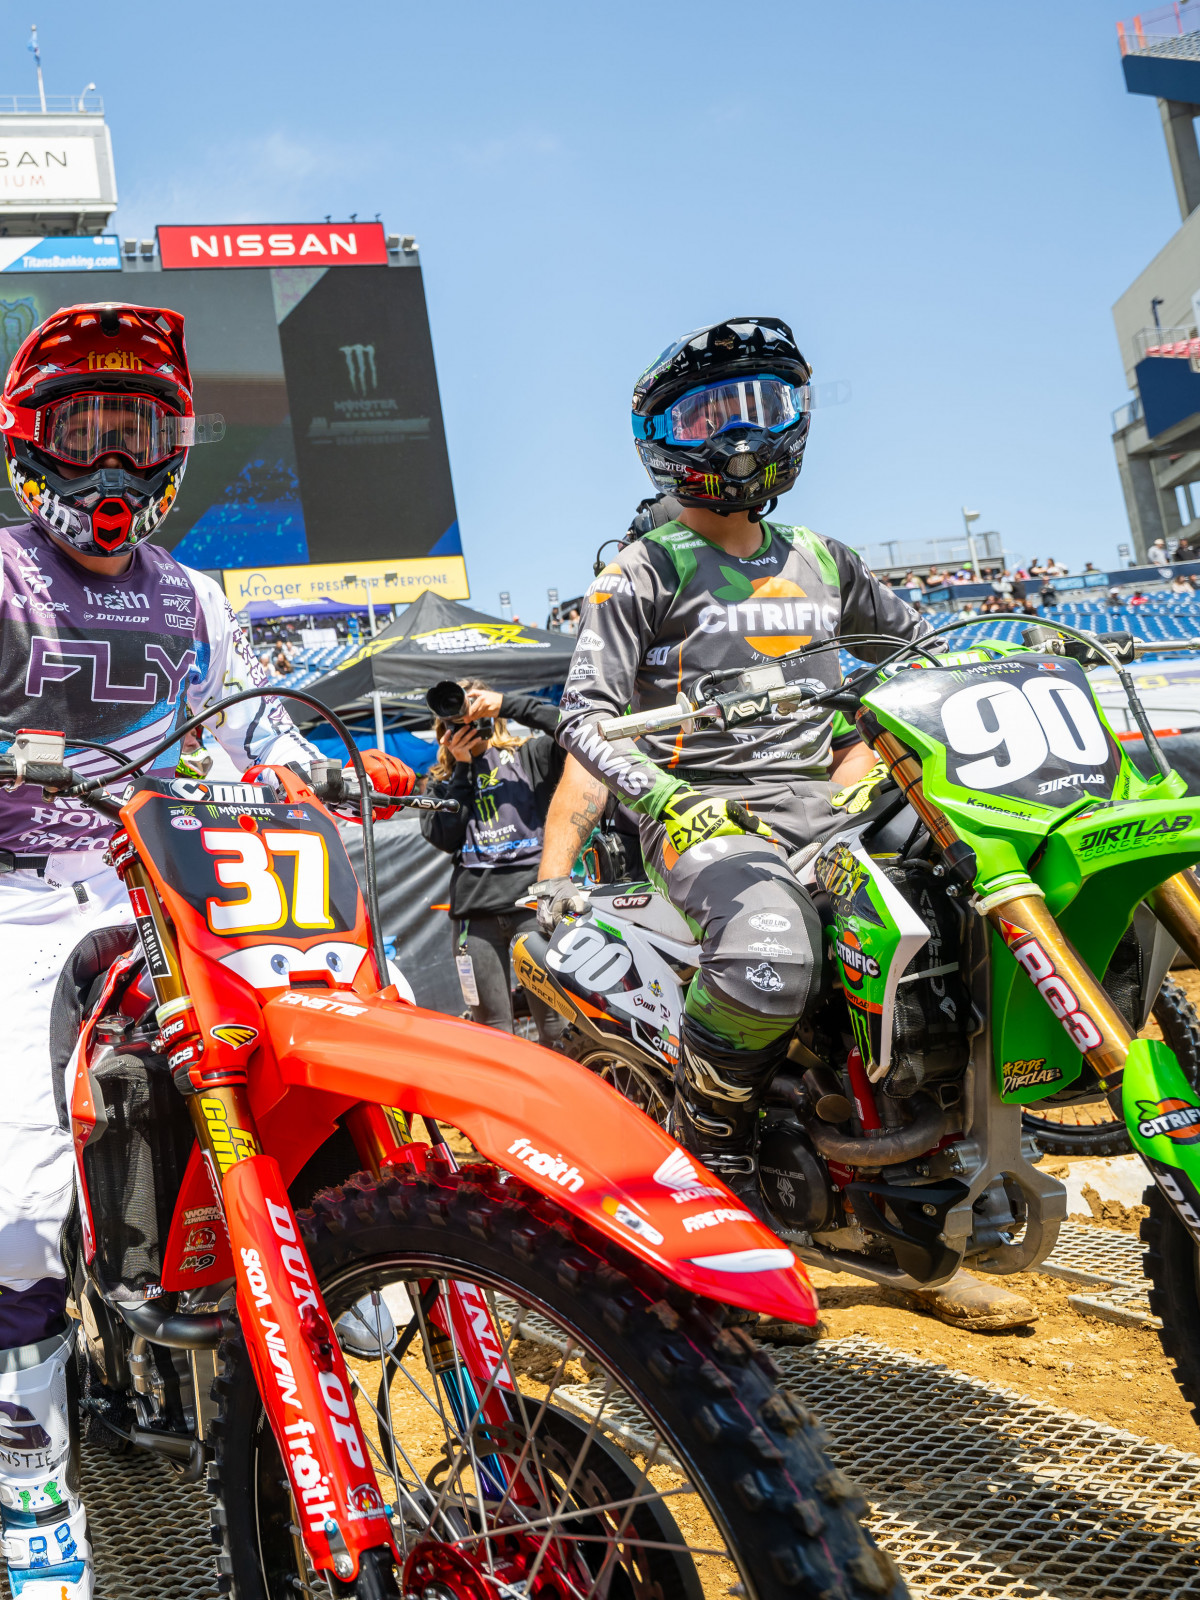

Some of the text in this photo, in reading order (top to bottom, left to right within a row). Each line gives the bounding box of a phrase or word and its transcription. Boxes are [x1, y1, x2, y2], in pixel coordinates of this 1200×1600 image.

[190, 233, 358, 257] NISSAN
[22, 254, 119, 269] TitansBanking.com
[87, 348, 143, 371] froth
[33, 410, 42, 442] OAKLEY
[159, 574, 190, 588] AMA
[240, 573, 302, 600] Kroger
[311, 579, 350, 592] FRESH
[354, 578, 379, 589] FOR
[29, 594, 71, 612] boost
[83, 586, 150, 610] froth
[161, 594, 193, 613] SMX
[96, 612, 150, 624] DUNLOP
[164, 613, 197, 631] WPS
[699, 604, 839, 635] CITRIFIC
[646, 646, 671, 666] 90
[25, 636, 197, 705] FLY
[967, 662, 1025, 675] MONSTER
[728, 697, 768, 721] ASV
[941, 676, 1109, 790] 90
[752, 751, 801, 760] MOTOMUCK
[1036, 774, 1106, 796] DIRTLAB
[168, 805, 197, 817] SMX
[218, 805, 276, 817] MONSTER
[411, 799, 442, 810] ASV
[966, 797, 1032, 822] Kawasaki
[31, 806, 117, 830] HON
[177, 819, 199, 827] AMA
[672, 805, 720, 851] FXR
[111, 833, 128, 849] TRIG
[1076, 815, 1193, 852] DIRTLAB
[1082, 832, 1180, 859] CONCEPTS
[201, 828, 335, 934] 37
[614, 895, 648, 907] GUTS
[141, 921, 162, 970] GENUINE
[836, 938, 880, 976] CITRIFIC
[519, 959, 548, 984] RP
[545, 927, 633, 992] 90
[279, 992, 369, 1017] ANSTIE
[1013, 937, 1104, 1055] RG3
[652, 1036, 679, 1059] CITRI
[1139, 1108, 1200, 1138] CITRIF
[507, 1138, 585, 1194] froth
[759, 1165, 806, 1181] REKLUSE
[670, 1187, 729, 1204] HONDA
[184, 1214, 222, 1225] CONNECTIO
[240, 1247, 273, 1313] SKDA
[265, 1196, 370, 1470] DUNOP
[284, 1417, 338, 1534] froth
